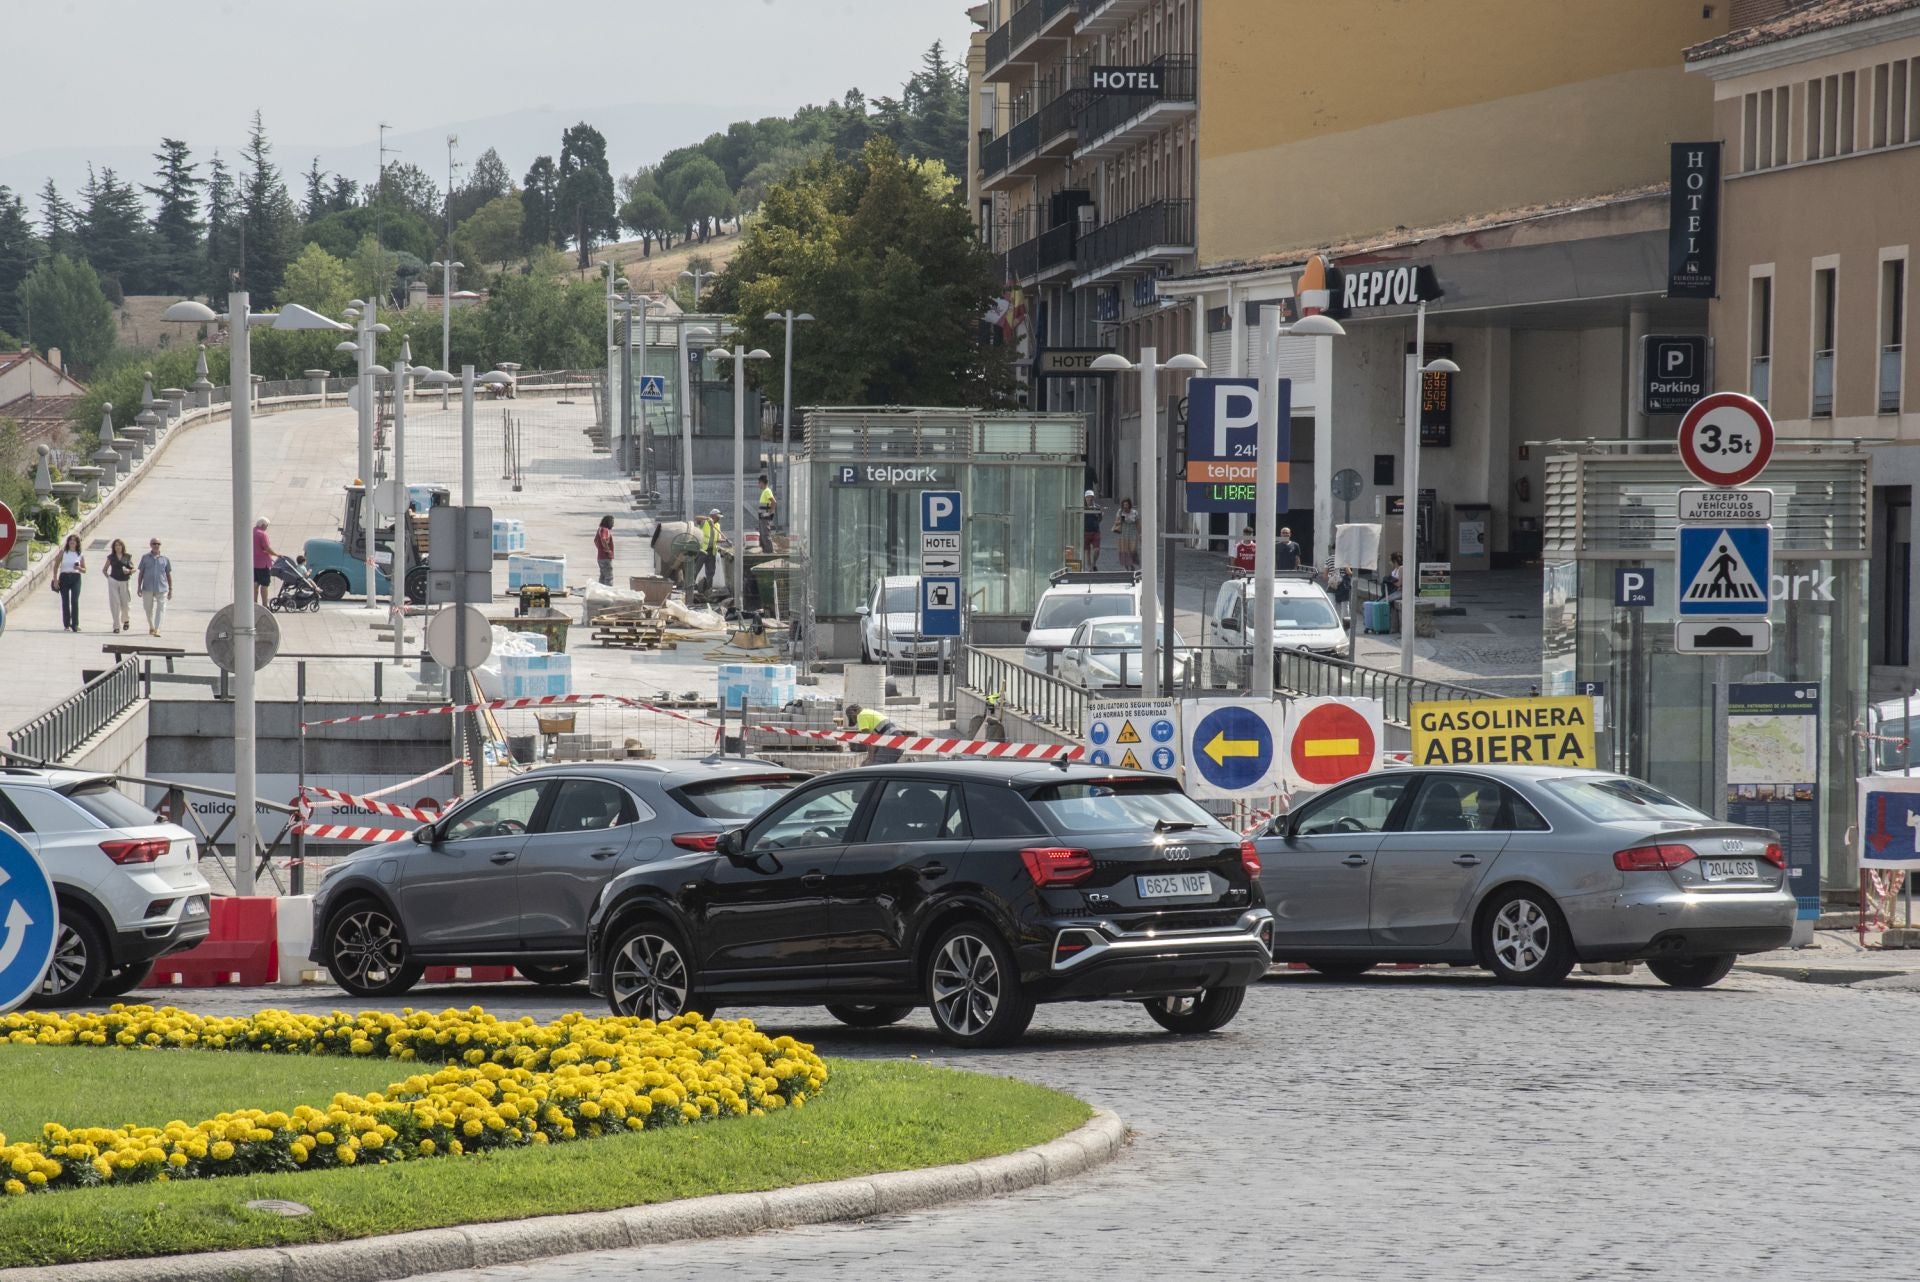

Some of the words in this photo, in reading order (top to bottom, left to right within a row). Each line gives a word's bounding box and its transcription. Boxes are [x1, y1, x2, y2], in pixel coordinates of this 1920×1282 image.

[1093, 72, 1159, 89] HOTEL
[1687, 151, 1704, 254] HOTEL
[1343, 267, 1419, 308] REPSOL
[1052, 355, 1097, 367] HOTE
[1667, 350, 1684, 371] P
[1650, 381, 1700, 395] Parking
[1214, 385, 1259, 456] P
[843, 468, 854, 482] P
[867, 466, 937, 485] telpark
[1208, 464, 1258, 480] telpar
[1213, 484, 1256, 500] LIBRE
[929, 497, 953, 527] P
[1689, 510, 1761, 518] AUTORIZADOS
[1697, 501, 1753, 510] VEHÍCULOS
[926, 538, 957, 548] HOTEL
[1624, 573, 1644, 601] P
[1772, 569, 1837, 601] ark
[1097, 702, 1129, 711] OBLIGATORIO
[1130, 701, 1152, 709] SEGUIR
[1153, 700, 1172, 708] TODAS
[1134, 709, 1167, 717] SEGURIDAD
[1421, 707, 1585, 731] GASOLINERA
[1424, 732, 1585, 765] ABIERTA
[1709, 862, 1734, 876] 2044
[1736, 862, 1755, 875] GSS
[1146, 877, 1179, 893] 6625
[1183, 876, 1206, 892] NBF
